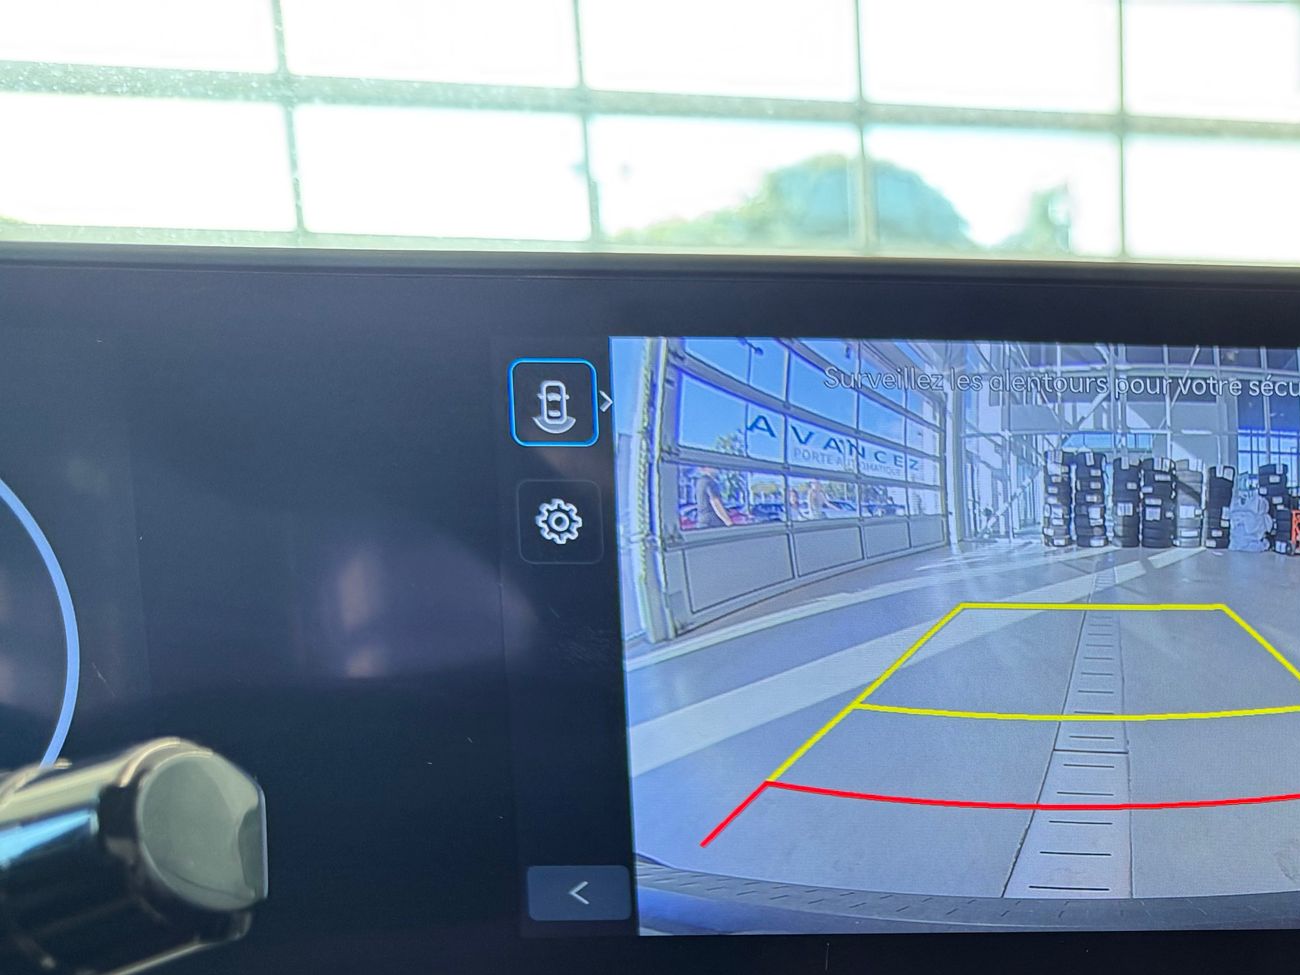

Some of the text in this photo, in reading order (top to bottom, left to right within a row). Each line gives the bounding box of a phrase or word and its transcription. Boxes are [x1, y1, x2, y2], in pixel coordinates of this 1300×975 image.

[823, 366, 944, 391] Surveillez
[950, 367, 983, 392] les
[989, 367, 1109, 394] alentours
[1115, 375, 1173, 398] pour
[1179, 376, 1242, 397] votre
[746, 415, 919, 471] AVANCEZ
[793, 447, 834, 466] PORTE
